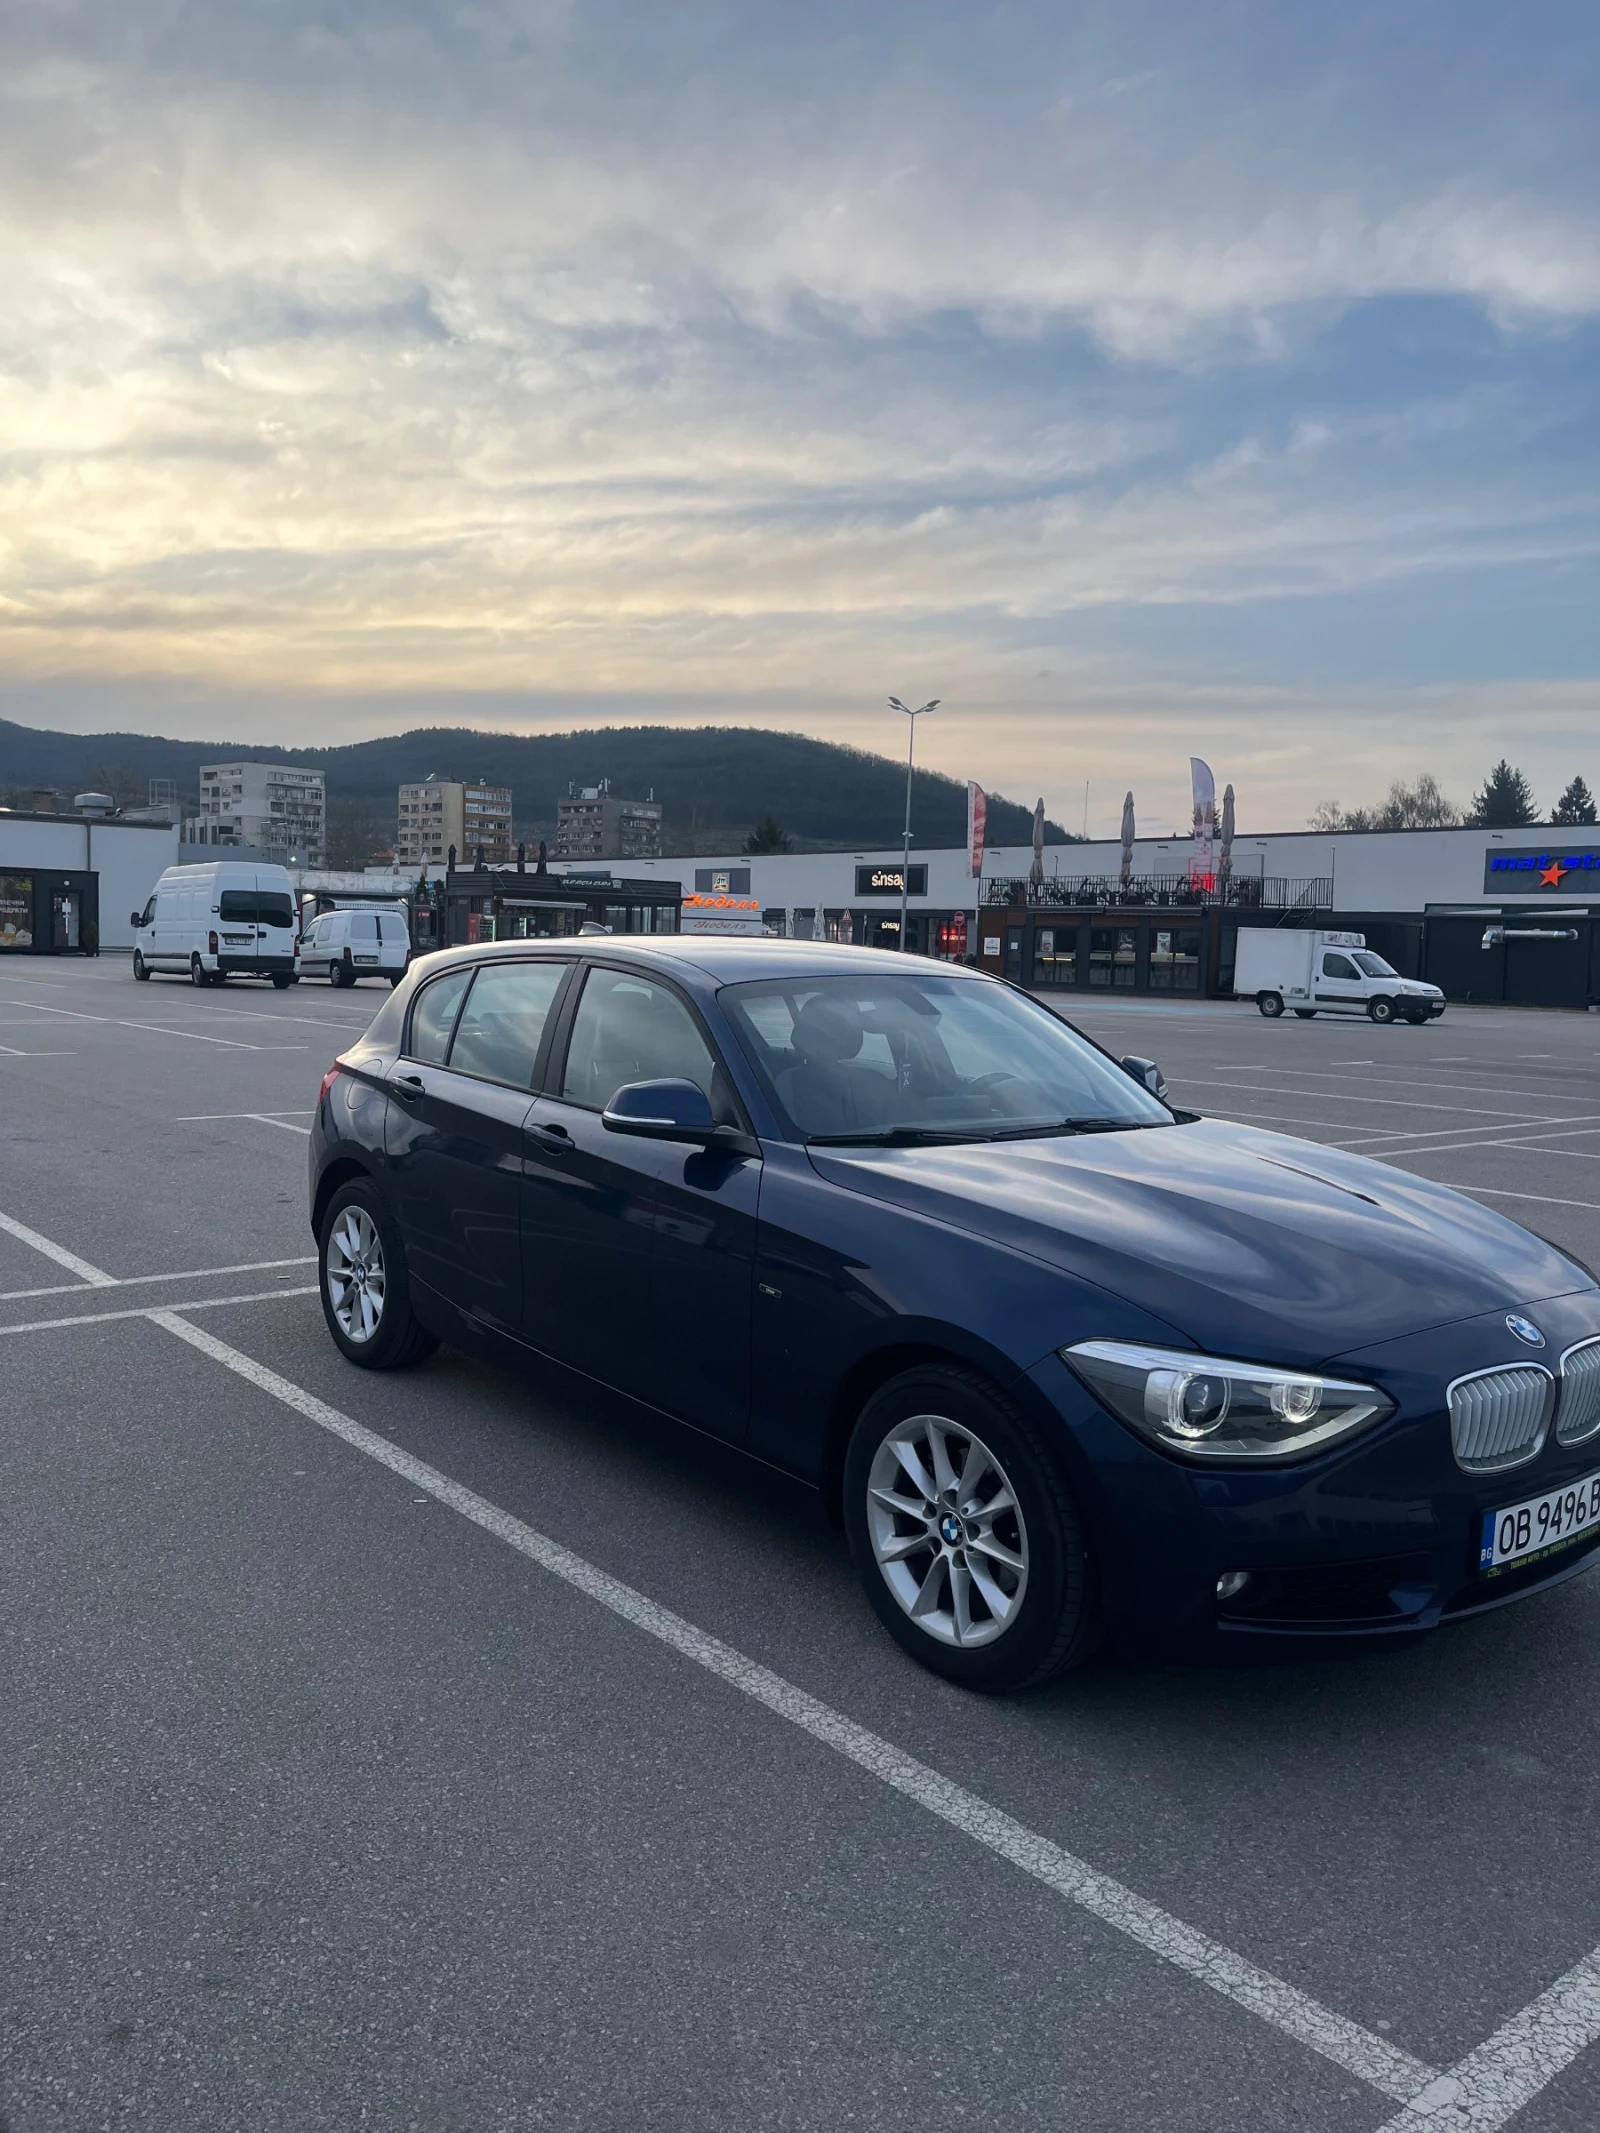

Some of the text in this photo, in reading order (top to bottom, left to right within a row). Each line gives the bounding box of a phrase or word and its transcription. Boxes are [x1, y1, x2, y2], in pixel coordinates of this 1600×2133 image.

[1490, 852, 1600, 871] mat st
[682, 894, 759, 910] Неделя
[693, 921, 747, 930] Неделя
[881, 920, 900, 932] sinsay
[1499, 1508, 1531, 1555] OB
[1537, 1484, 1586, 1543] 9496
[1480, 1547, 1492, 1562] BG
